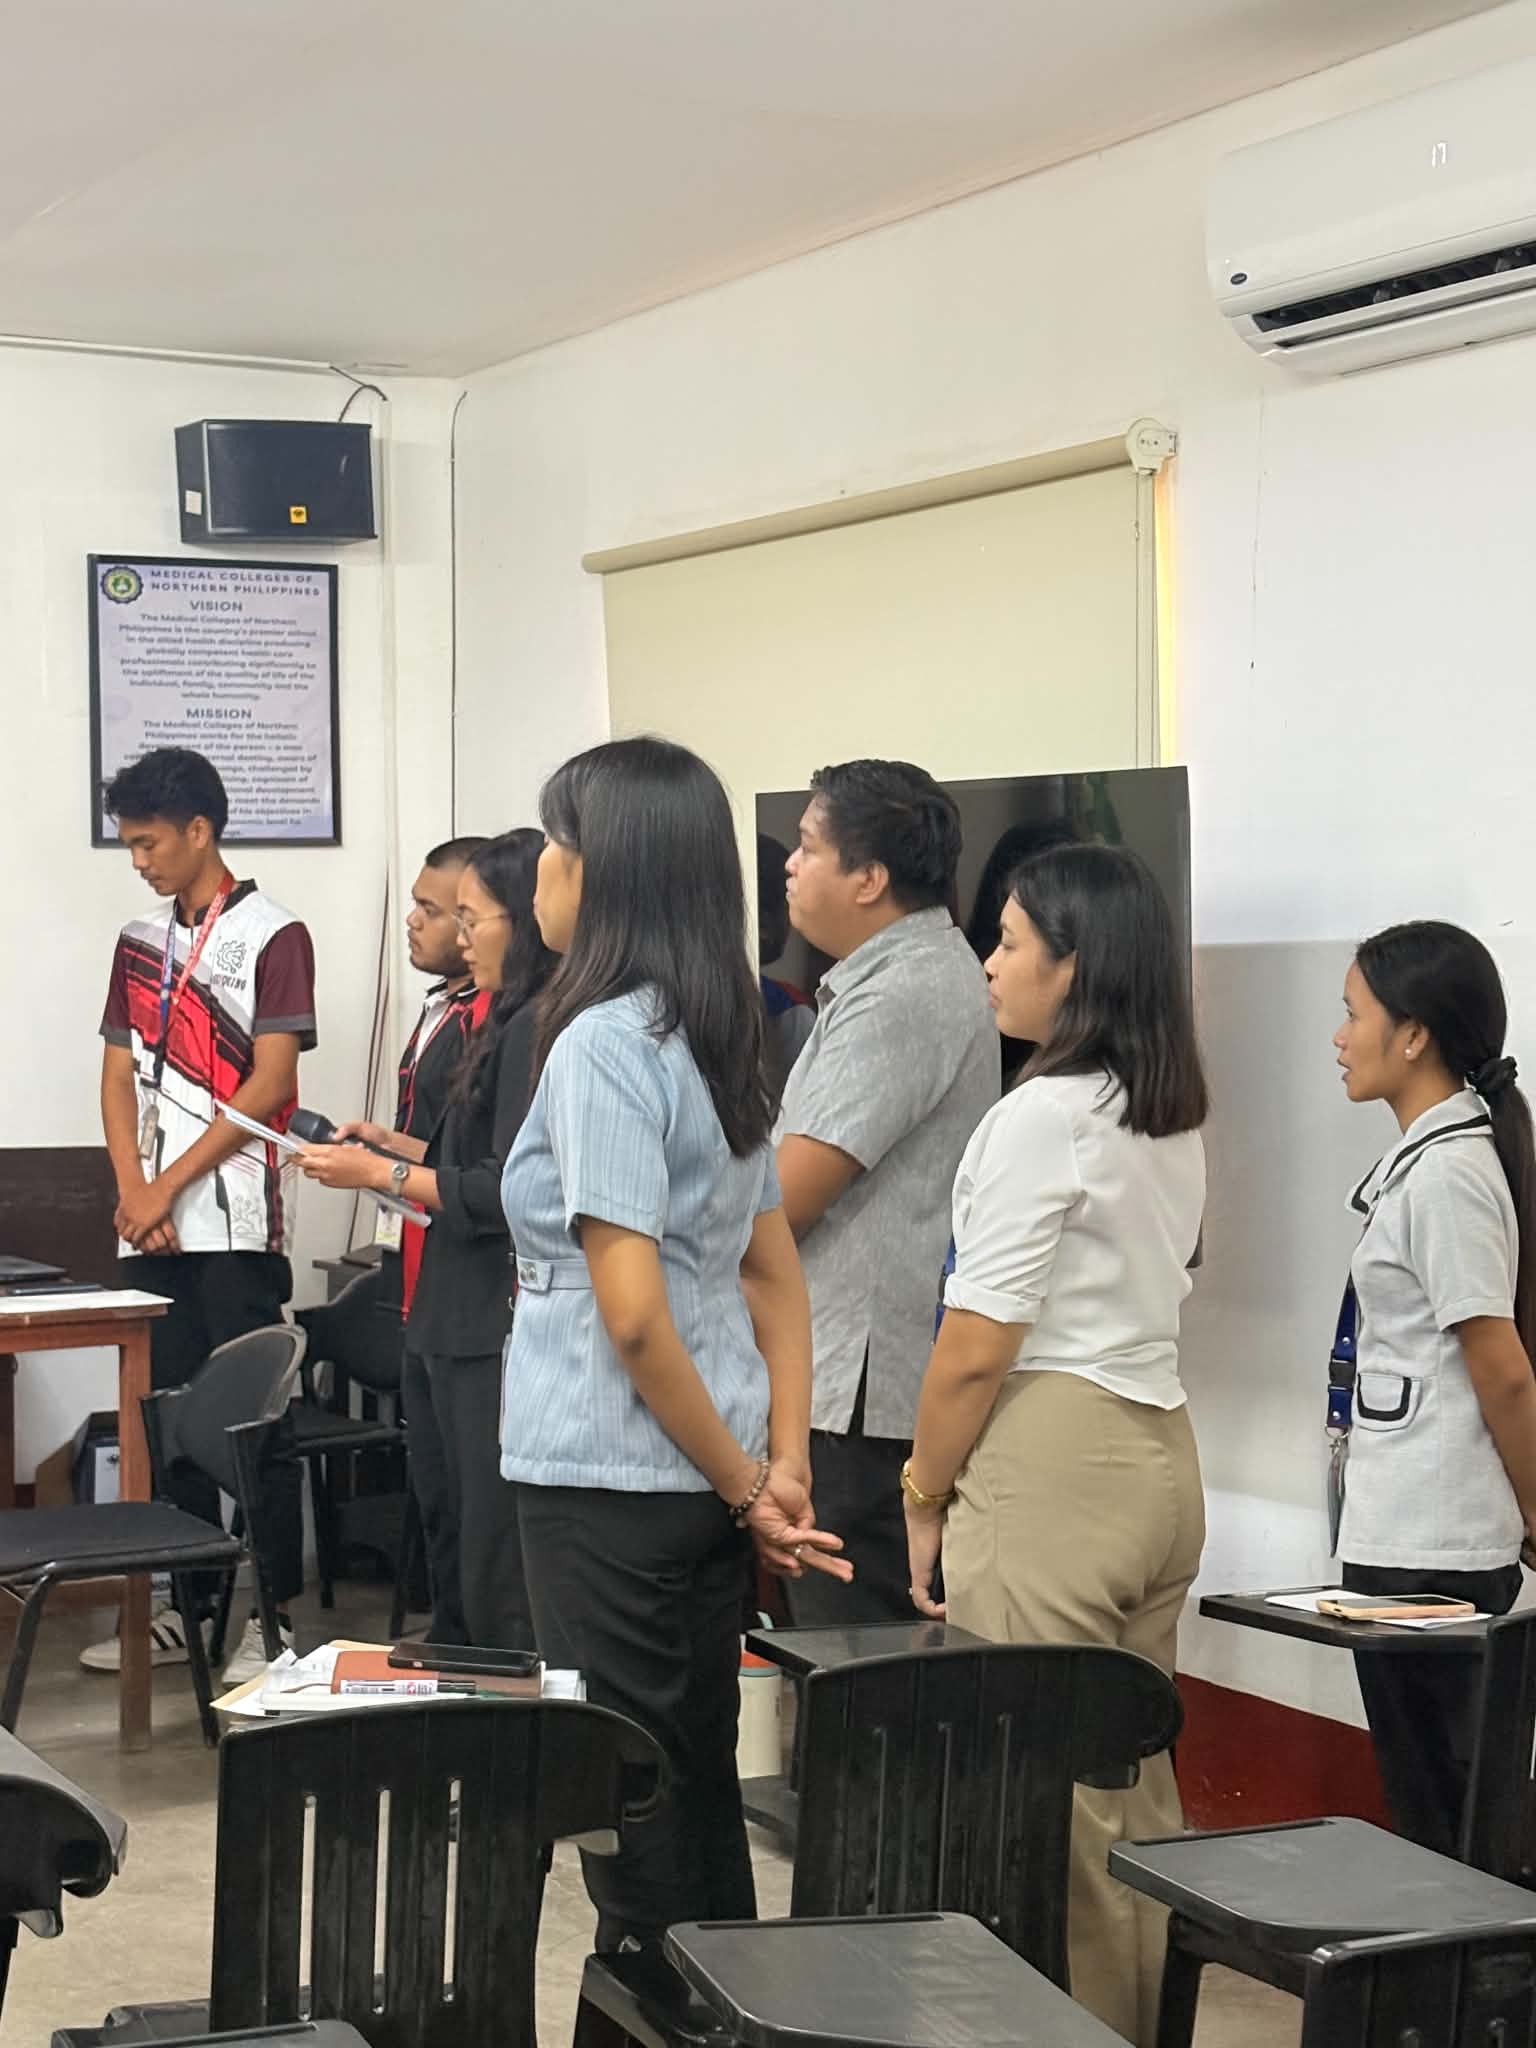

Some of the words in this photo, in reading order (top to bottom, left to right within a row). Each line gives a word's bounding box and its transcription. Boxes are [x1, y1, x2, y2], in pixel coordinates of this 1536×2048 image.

[151, 570, 215, 580] MEDICAL
[219, 571, 290, 583] COLLEGES
[295, 574, 313, 583] OF
[151, 582, 228, 593] NORTHERN
[233, 584, 320, 597] PHILIPPINES
[190, 600, 243, 613] VISION
[185, 707, 253, 719] MISSION
